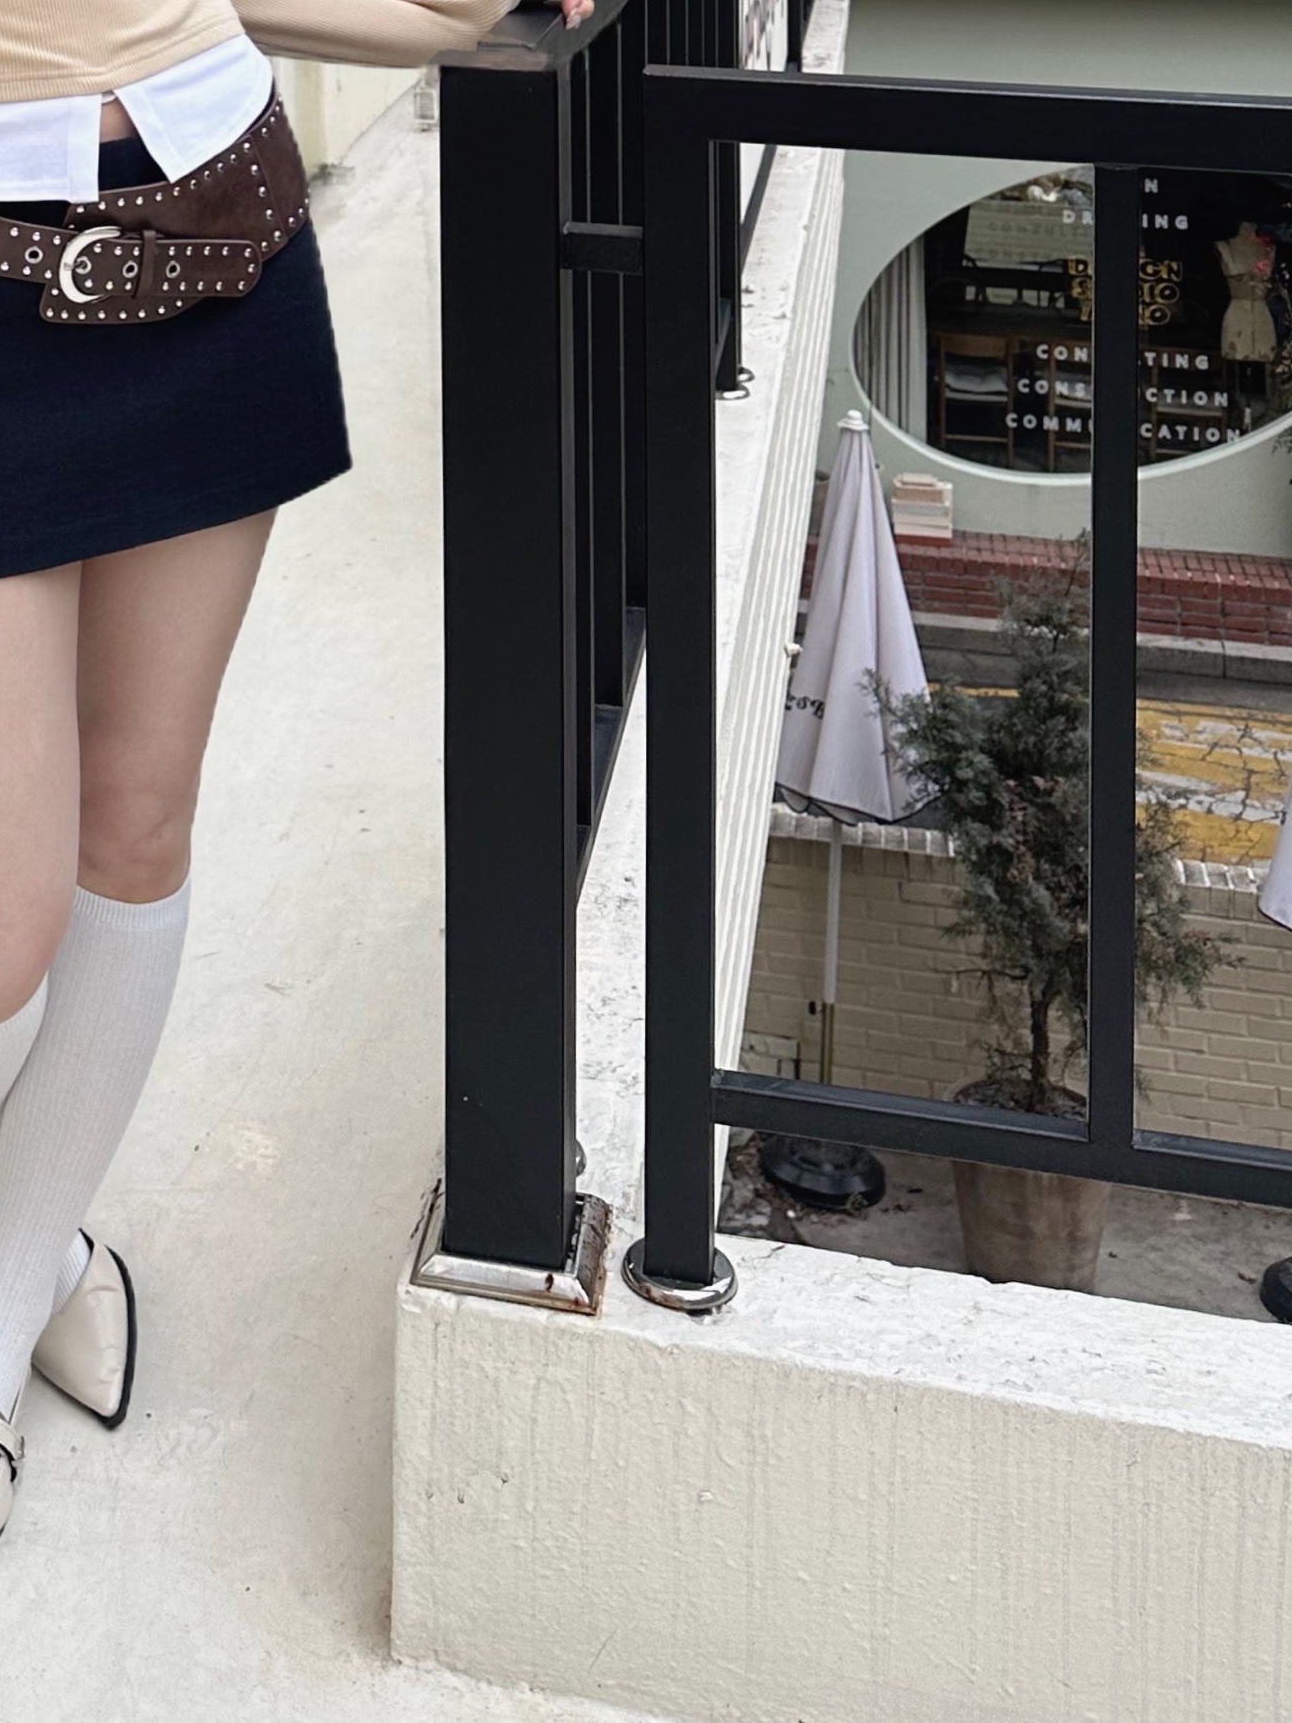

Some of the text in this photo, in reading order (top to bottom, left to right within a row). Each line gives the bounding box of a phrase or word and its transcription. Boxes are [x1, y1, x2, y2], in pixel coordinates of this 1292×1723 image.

[1062, 209, 1189, 230] DRING
[1036, 343, 1209, 370] CONTING
[1017, 378, 1228, 407] CONSCTION
[1005, 412, 1241, 443] COMMCATION
